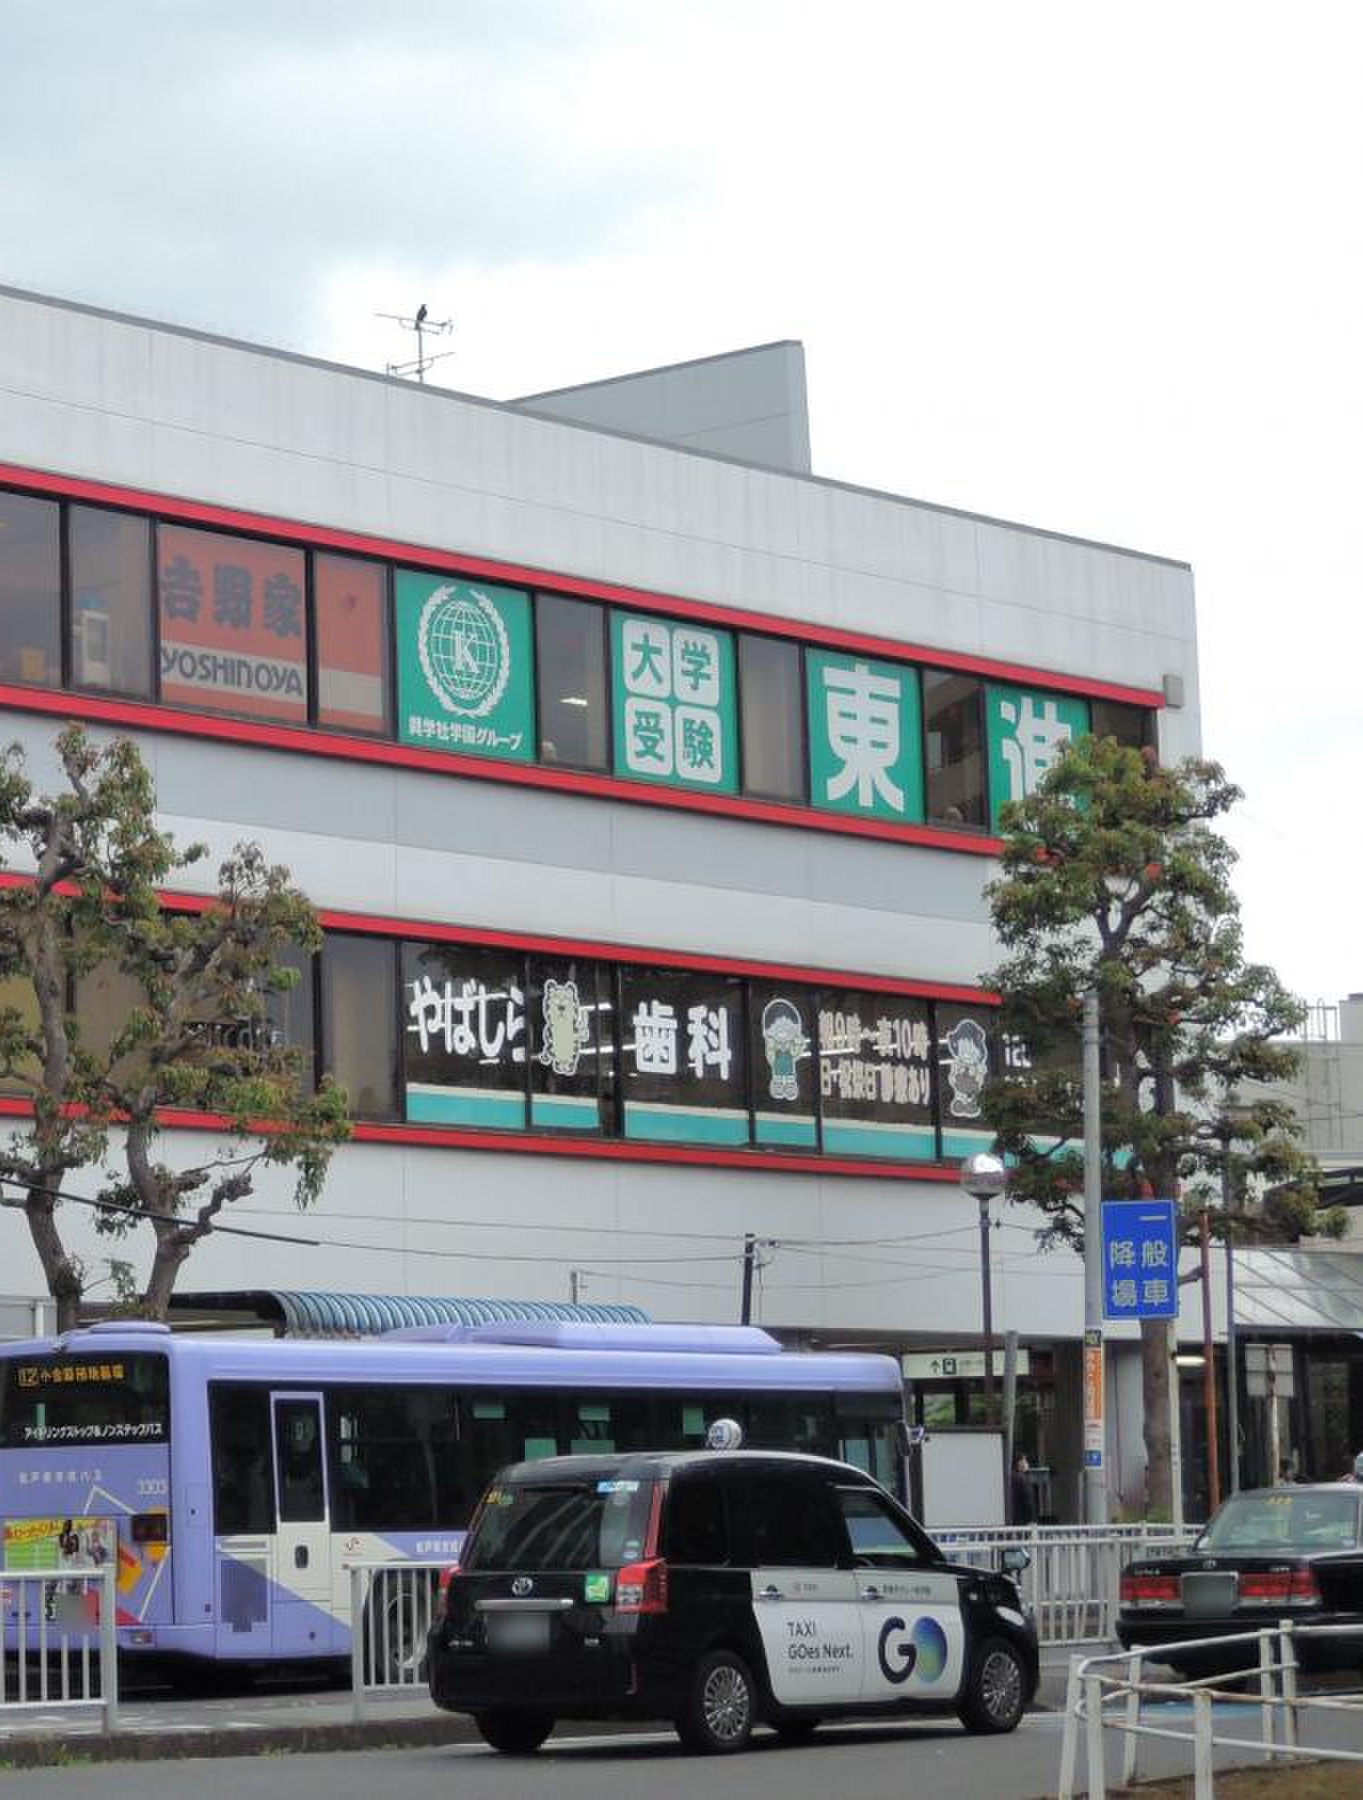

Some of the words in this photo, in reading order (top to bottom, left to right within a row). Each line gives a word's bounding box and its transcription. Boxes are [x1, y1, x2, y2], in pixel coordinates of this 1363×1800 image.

[161, 554, 303, 638] 吉野家
[161, 645, 304, 697] YOSHINOYA
[630, 633, 713, 692] 大学
[633, 711, 716, 770] 受験
[633, 1000, 732, 1080] 歯科
[1110, 1240, 1137, 1307] 降場
[1138, 1215, 1169, 1306] 一般車
[787, 1621, 816, 1638] TAXI
[788, 1643, 820, 1660] GOes
